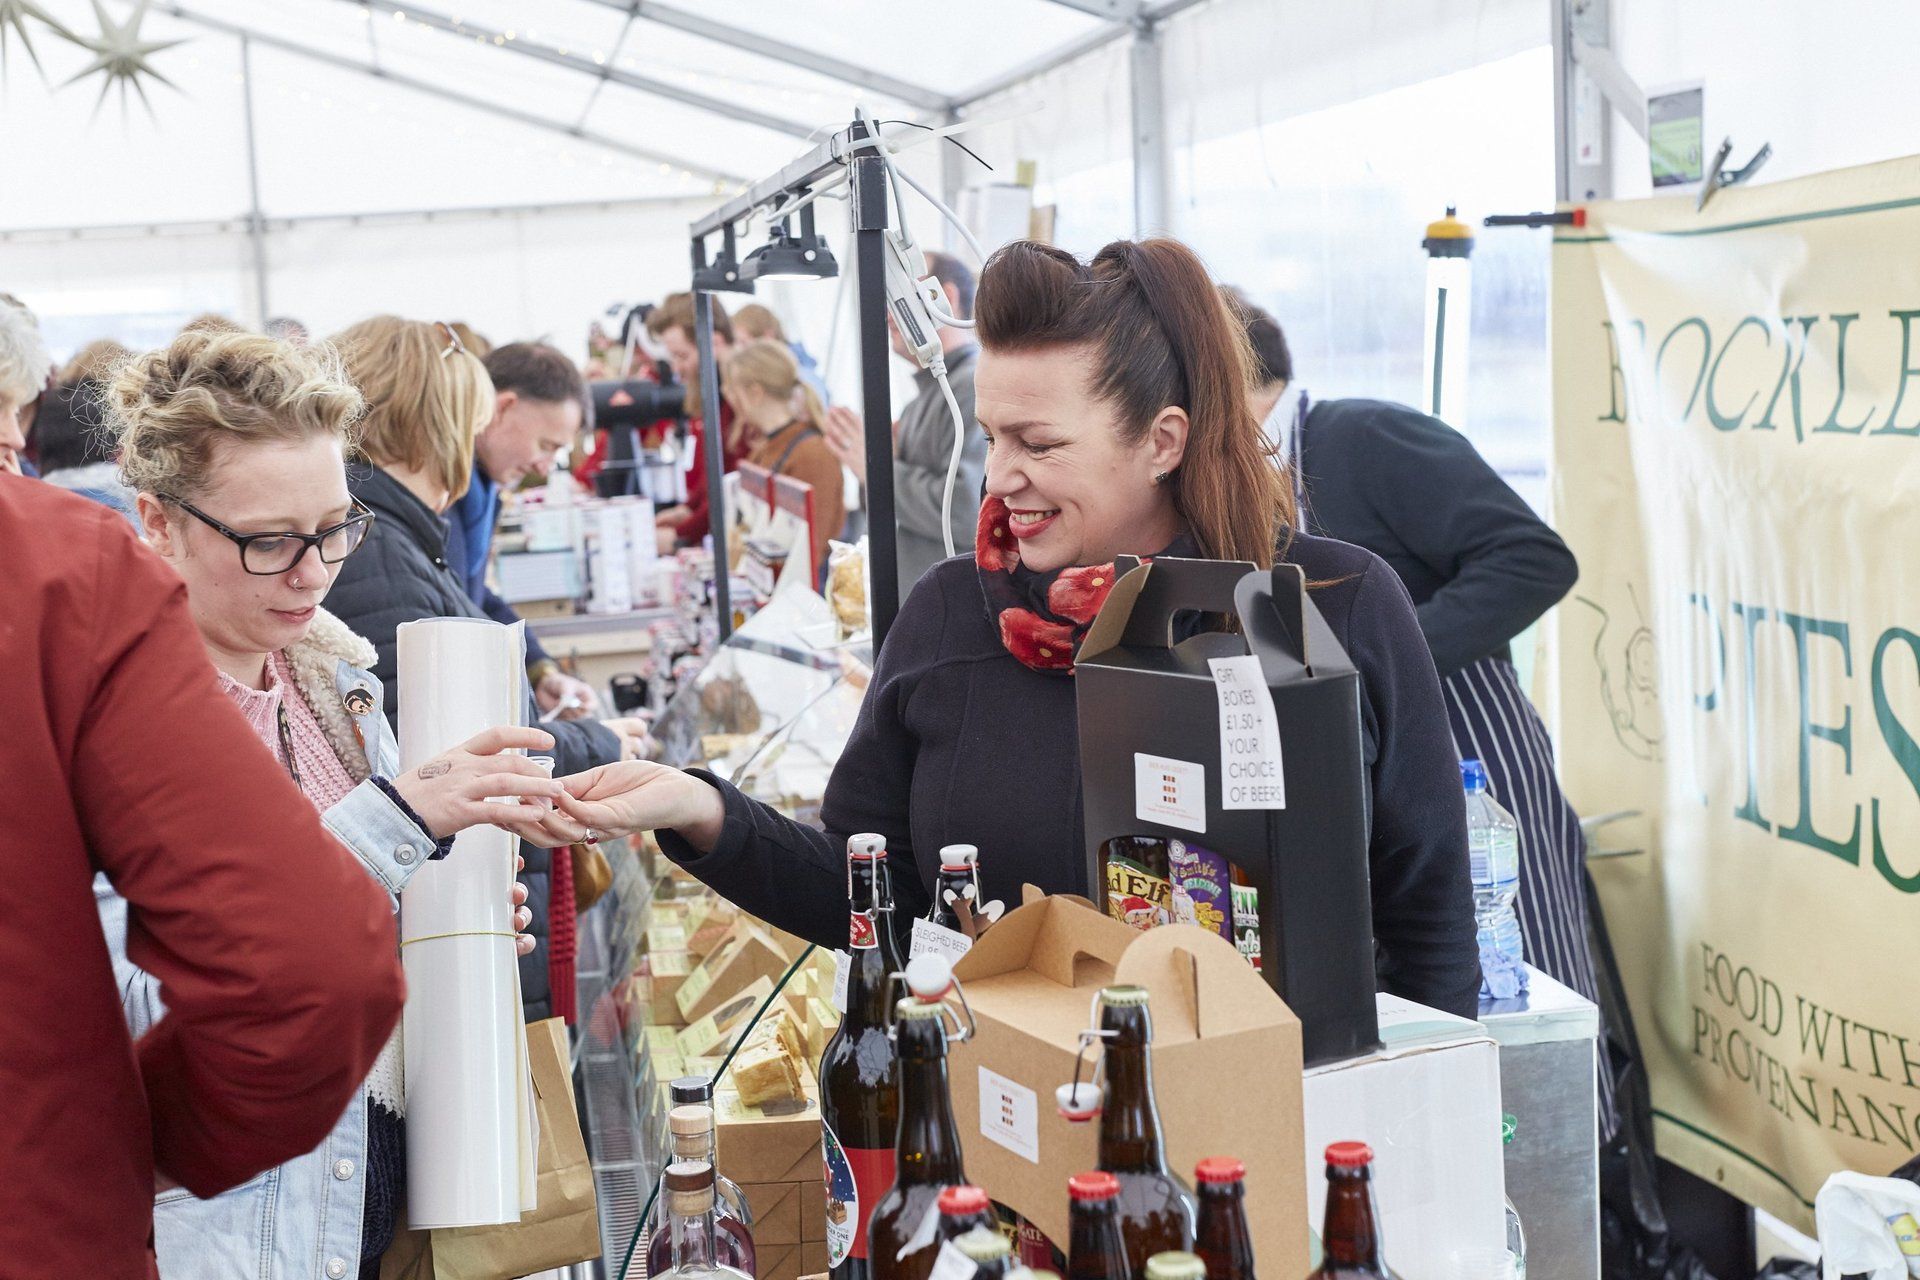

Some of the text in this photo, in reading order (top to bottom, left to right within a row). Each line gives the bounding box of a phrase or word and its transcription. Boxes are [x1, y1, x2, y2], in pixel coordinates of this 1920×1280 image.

[1223, 689, 1256, 706] BOXES
[1226, 713, 1254, 730] £1.50
[1227, 738, 1259, 754] YOUR
[1229, 761, 1276, 779] CHOICE
[1230, 785, 1282, 803] OF BEERS
[1126, 874, 1170, 904] Elf
[1701, 941, 1920, 1089] FOOD WITH
[1692, 1004, 1920, 1152] PROVENAN
